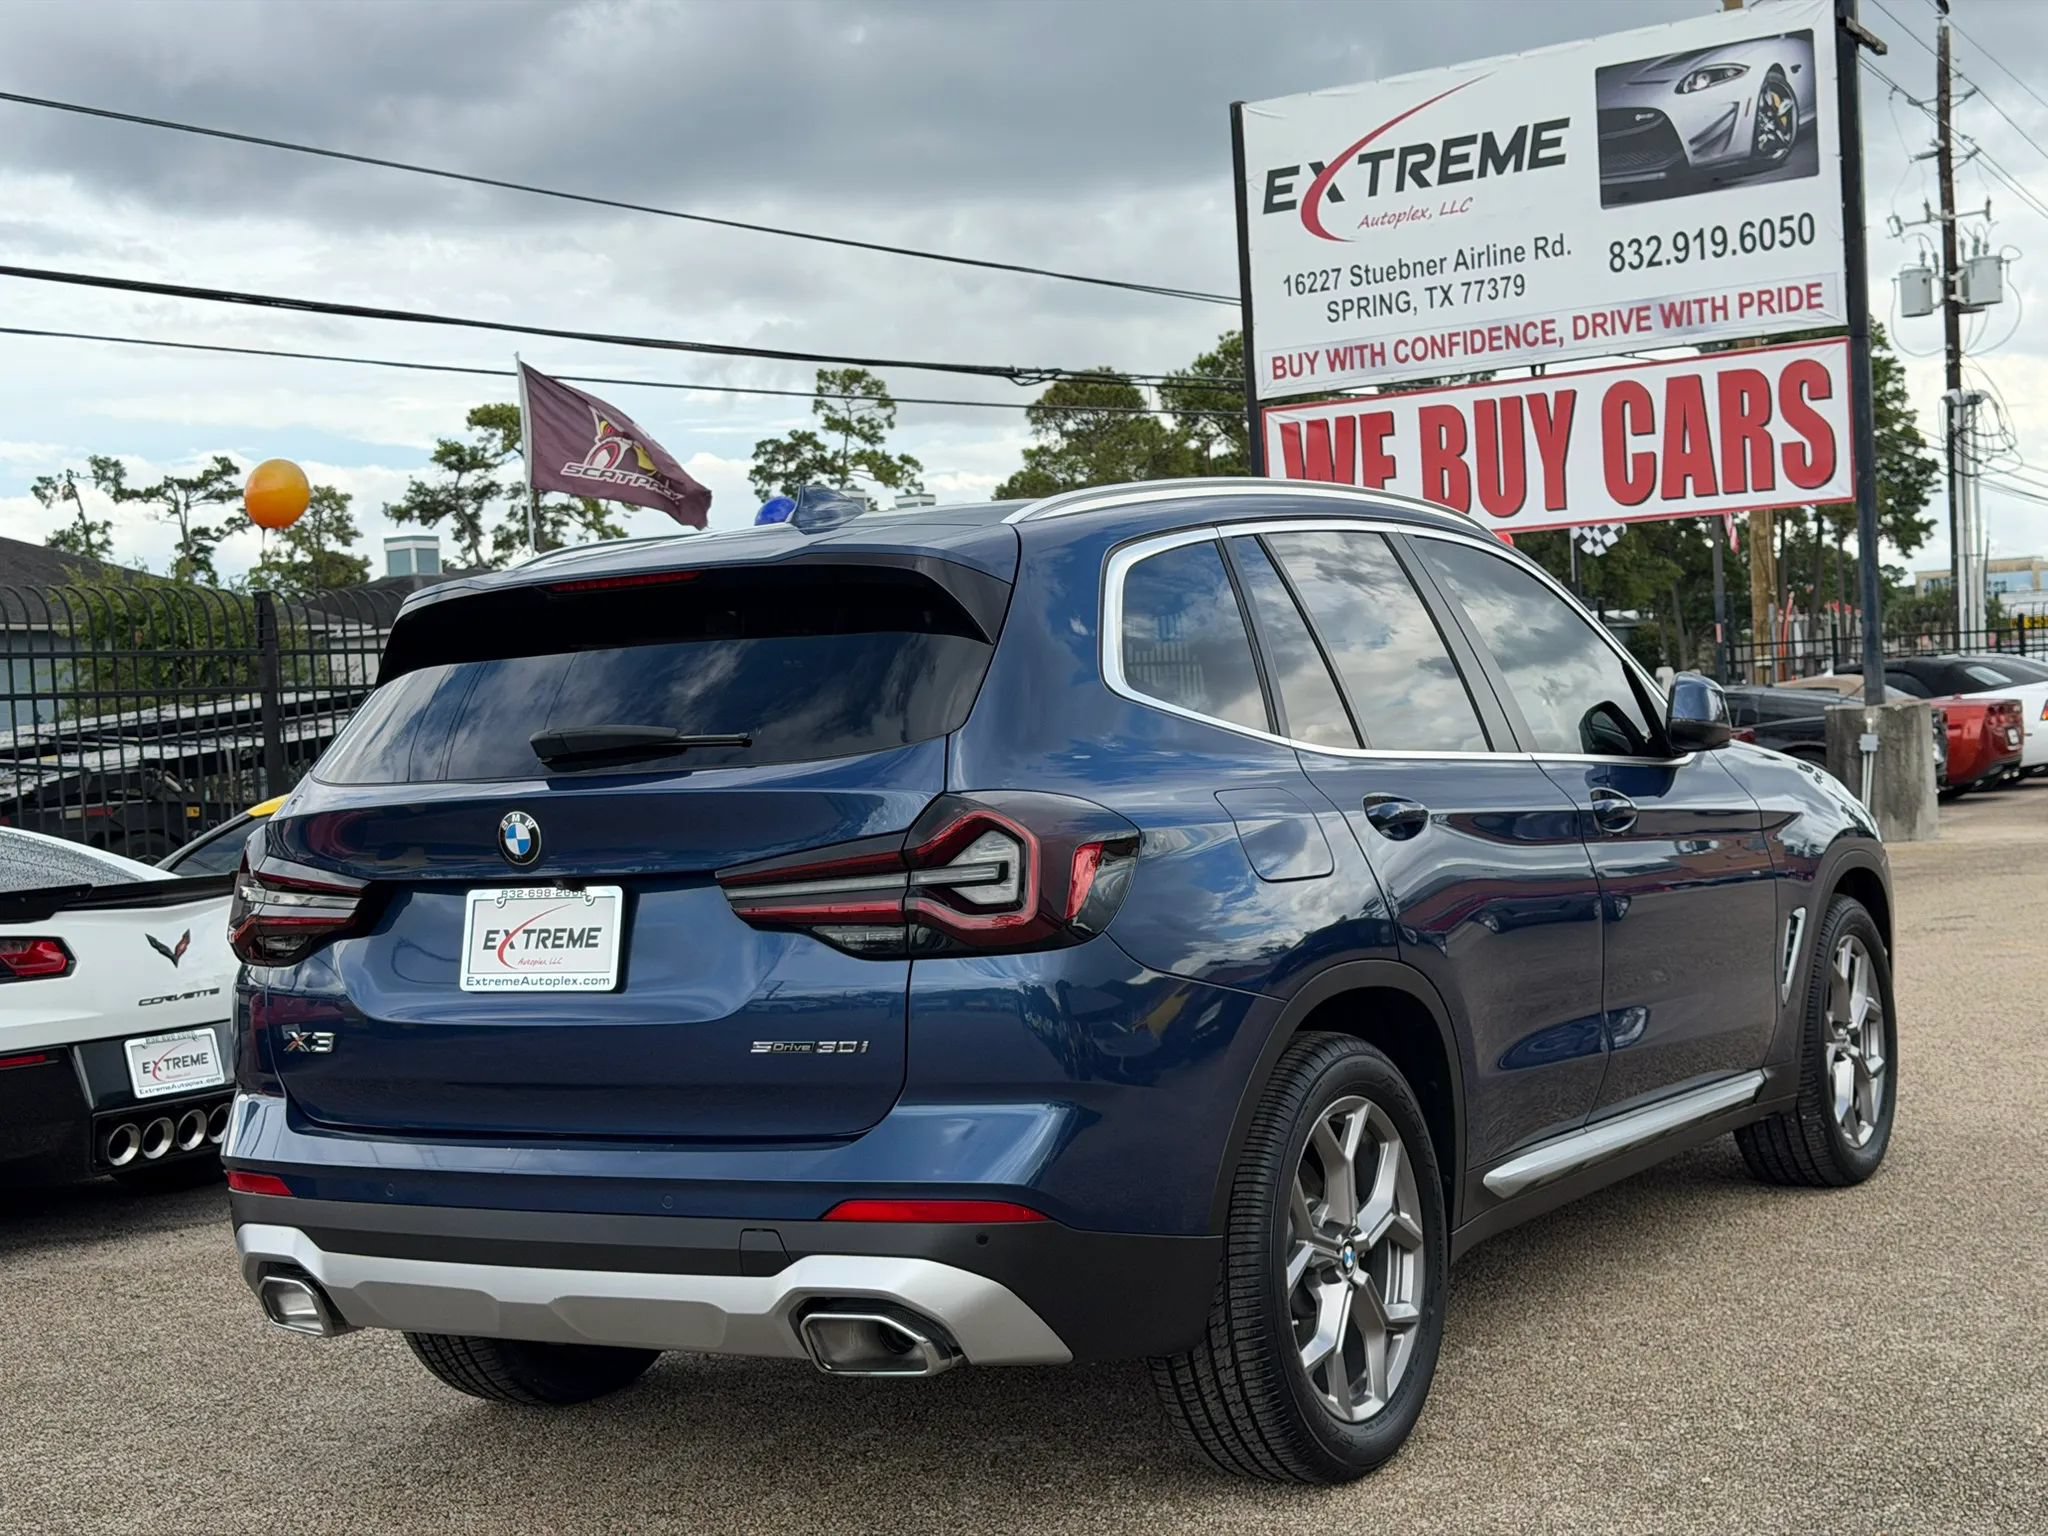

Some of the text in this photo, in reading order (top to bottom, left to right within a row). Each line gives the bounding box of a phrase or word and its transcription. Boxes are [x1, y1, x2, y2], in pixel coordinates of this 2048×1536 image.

[1263, 117, 1570, 215] EXTREME
[1357, 197, 1474, 230] Autoplex, LLC
[1608, 212, 1816, 273] 832.919.6050
[1283, 233, 1572, 297] 16227 Stuebner Airline Rd.
[1326, 273, 1526, 323] SPRING, TX 77379
[1271, 282, 1824, 380] BUY WITH CONFIDENCE, DRIVE WITH PRIDE
[1279, 358, 1836, 518] WE BUY CARS
[483, 927, 602, 950] EXTREME
[138, 987, 220, 1006] CORVETTE
[466, 976, 610, 988] ExtremeAutoplex.com
[283, 1031, 336, 1053] X3
[142, 1052, 209, 1074] EXTREME
